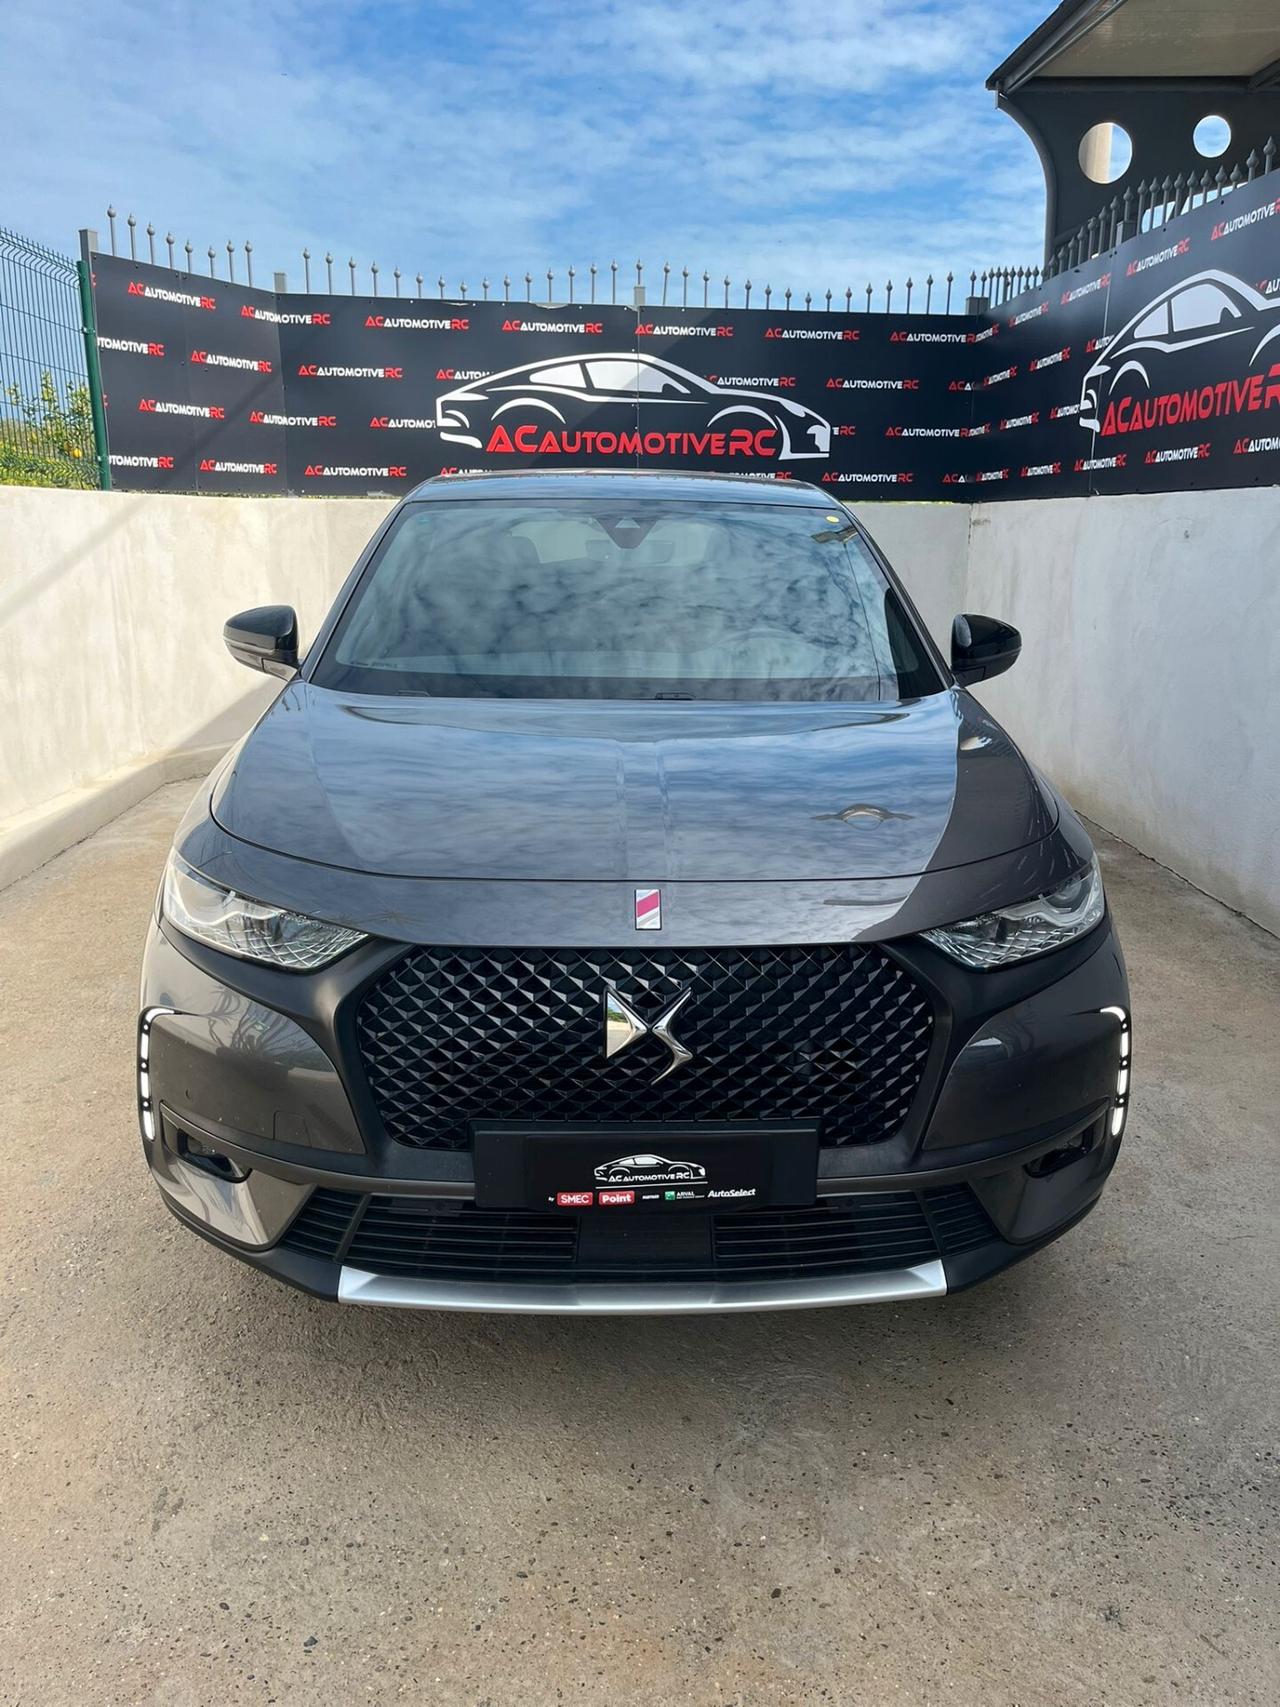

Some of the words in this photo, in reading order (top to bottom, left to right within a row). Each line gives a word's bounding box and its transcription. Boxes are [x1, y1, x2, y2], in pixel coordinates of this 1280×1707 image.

[1126, 238, 1190, 277] ACAUTOMOTIVERC
[127, 281, 217, 310] ACAUTOMOTIVERC
[240, 305, 331, 325] ACAUTOMOTIVERC
[364, 316, 470, 330] ACAUTOMOTIVERC
[502, 320, 603, 334] ACAUTOMOTIVERC
[635, 321, 734, 337] ACAUTOMOTIVERC
[764, 327, 860, 341] ACAUTOMOTIVERC
[191, 350, 272, 373] ACAUTOMOTIVERC
[298, 364, 403, 379] ACAUTOMOTIVERC
[826, 377, 919, 390] ACAUTOMOTIVERC
[138, 399, 225, 419] ACAUTOMOTIVERC
[250, 411, 336, 427] ACAUTOMOTIVERC
[486, 424, 778, 457] ACAUTOMOTIVERC
[1145, 443, 1211, 464] ACAUTOMOTIVERC
[200, 459, 277, 474] ACAUTOMOTIVERC
[304, 465, 407, 478] ACAUTOMOTIVERC
[822, 471, 914, 483] ACAUTOMOTIVERC
[561, 1194, 590, 1204] SMEC
[601, 1193, 632, 1203] Point
[707, 1188, 756, 1198] AutoSelect
